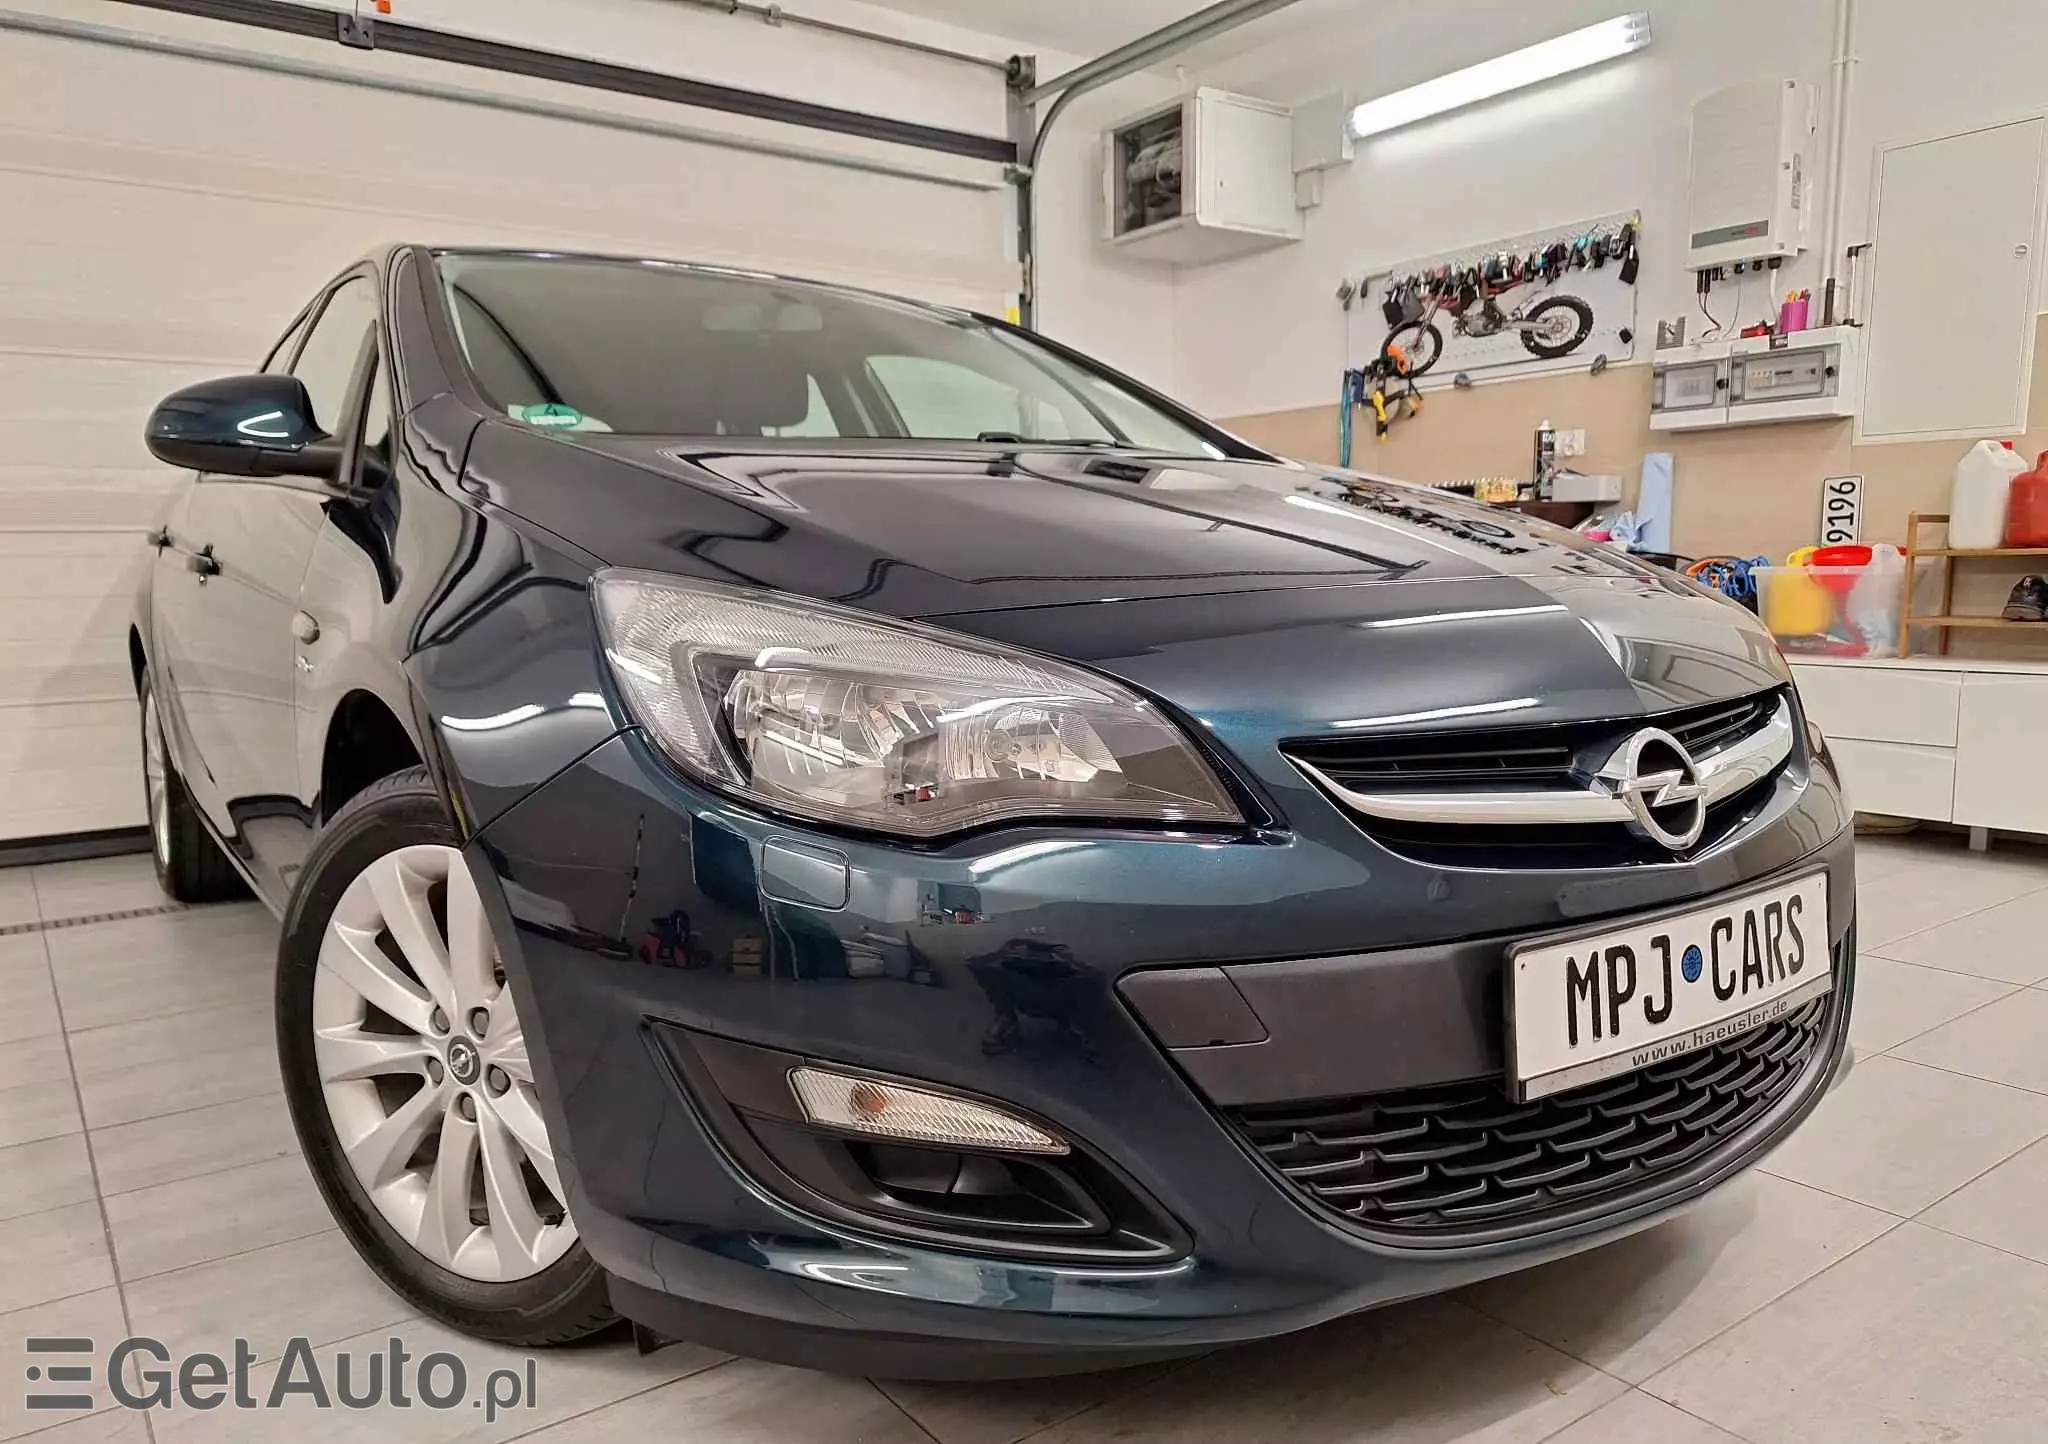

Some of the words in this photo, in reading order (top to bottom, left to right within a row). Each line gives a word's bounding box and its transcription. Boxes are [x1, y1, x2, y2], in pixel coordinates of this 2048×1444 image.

[1826, 481, 1856, 543] 9196
[1566, 934, 1673, 1046] MPJ
[1710, 894, 1805, 1001] CARS
[1631, 1001, 1788, 1067] www.haeusler.de
